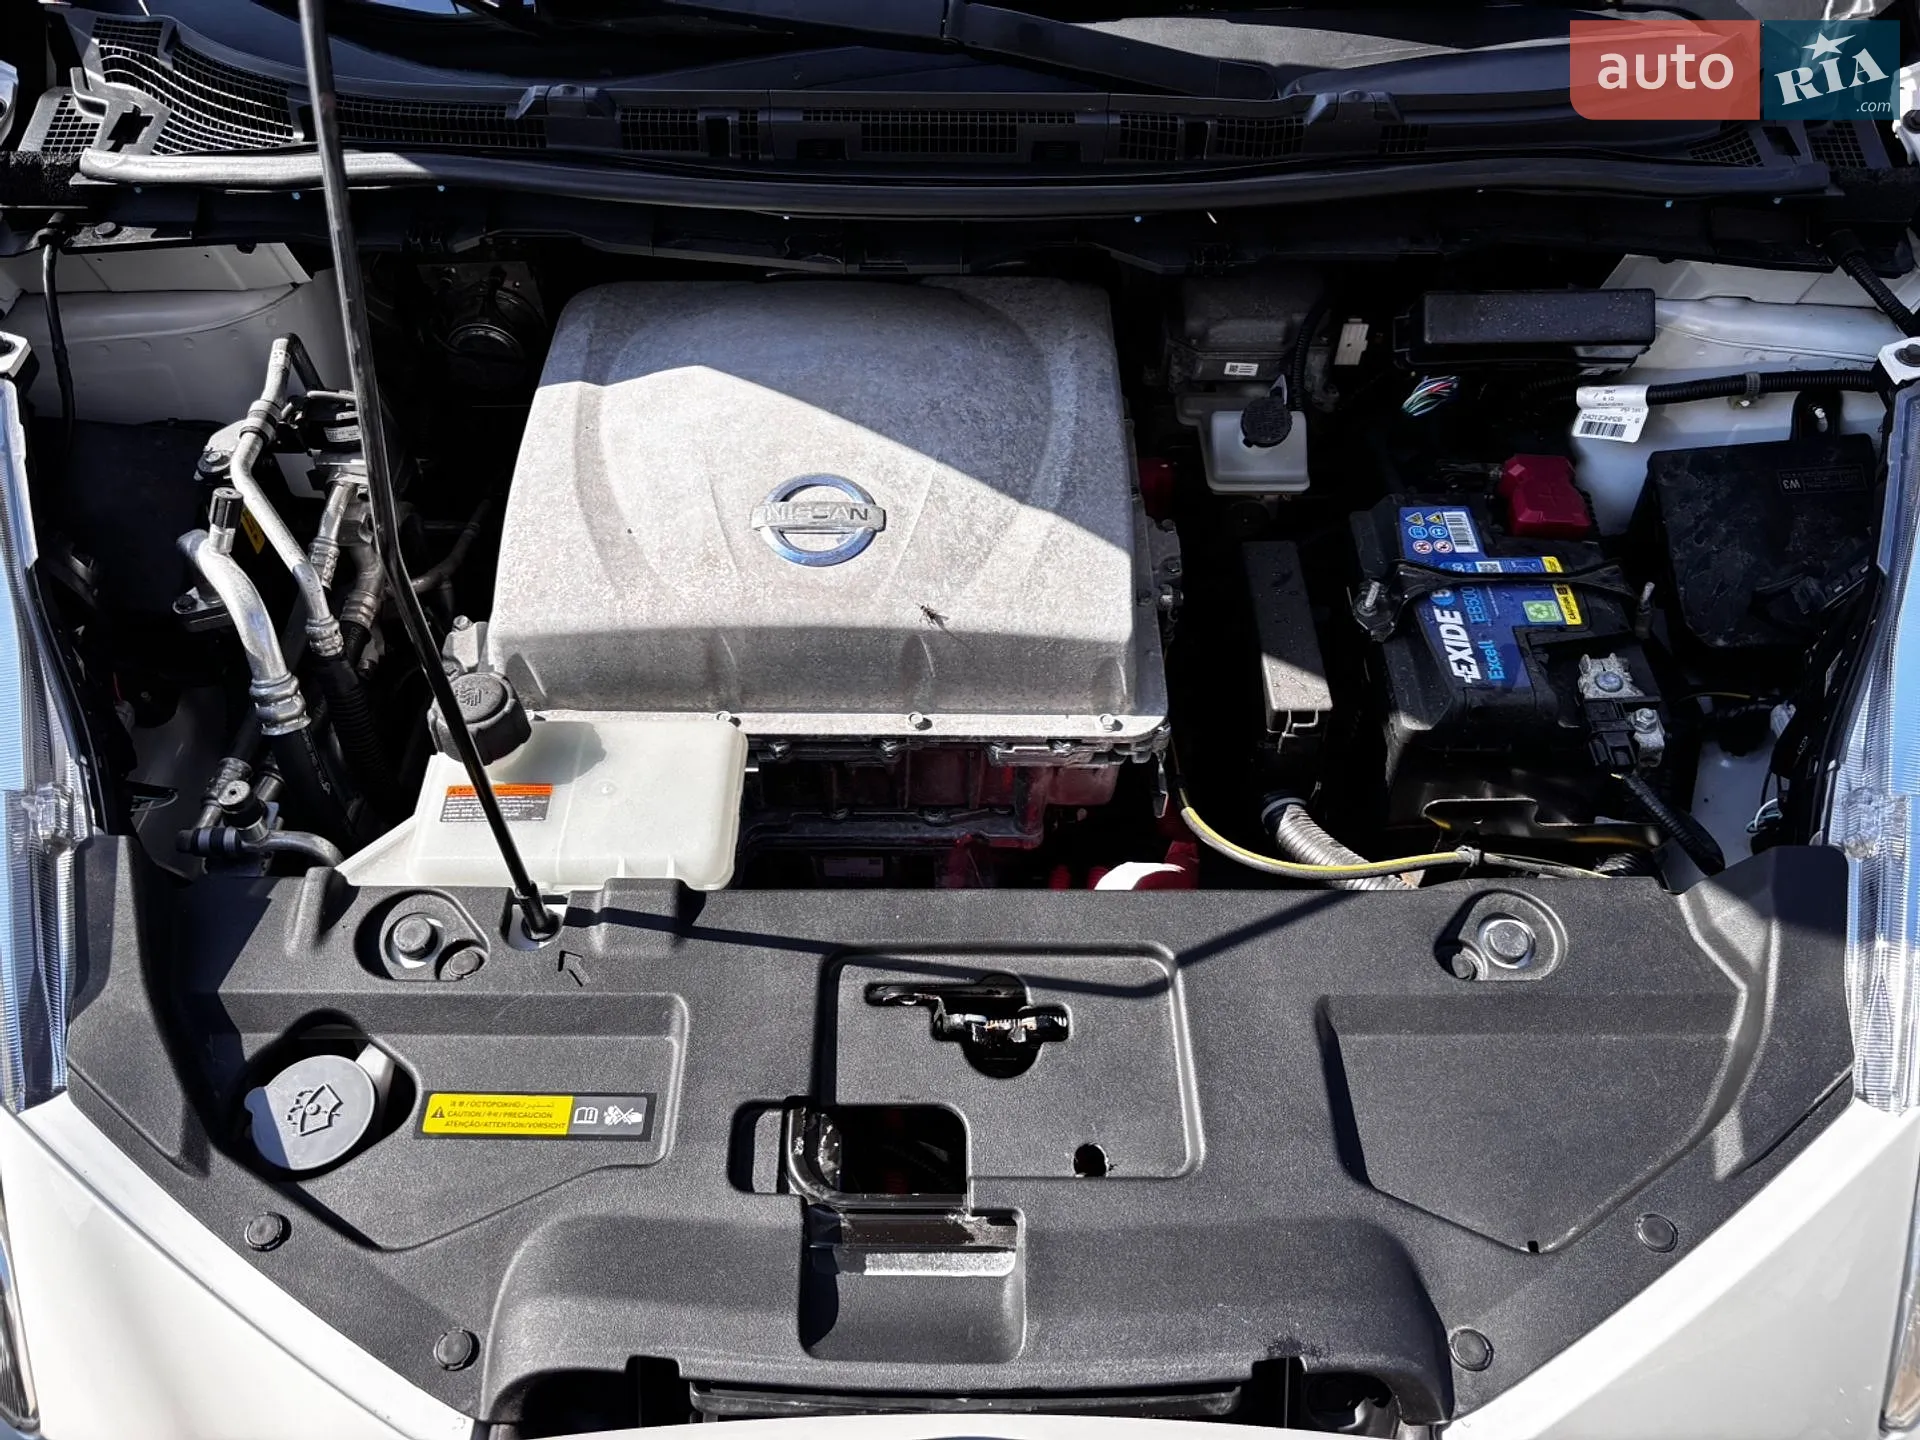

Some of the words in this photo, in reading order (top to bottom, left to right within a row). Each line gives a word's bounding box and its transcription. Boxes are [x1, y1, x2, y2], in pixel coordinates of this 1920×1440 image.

[766, 503, 868, 521] NISSAN
[1433, 607, 1482, 683] EXIDE
[1478, 639, 1507, 681] Excell
